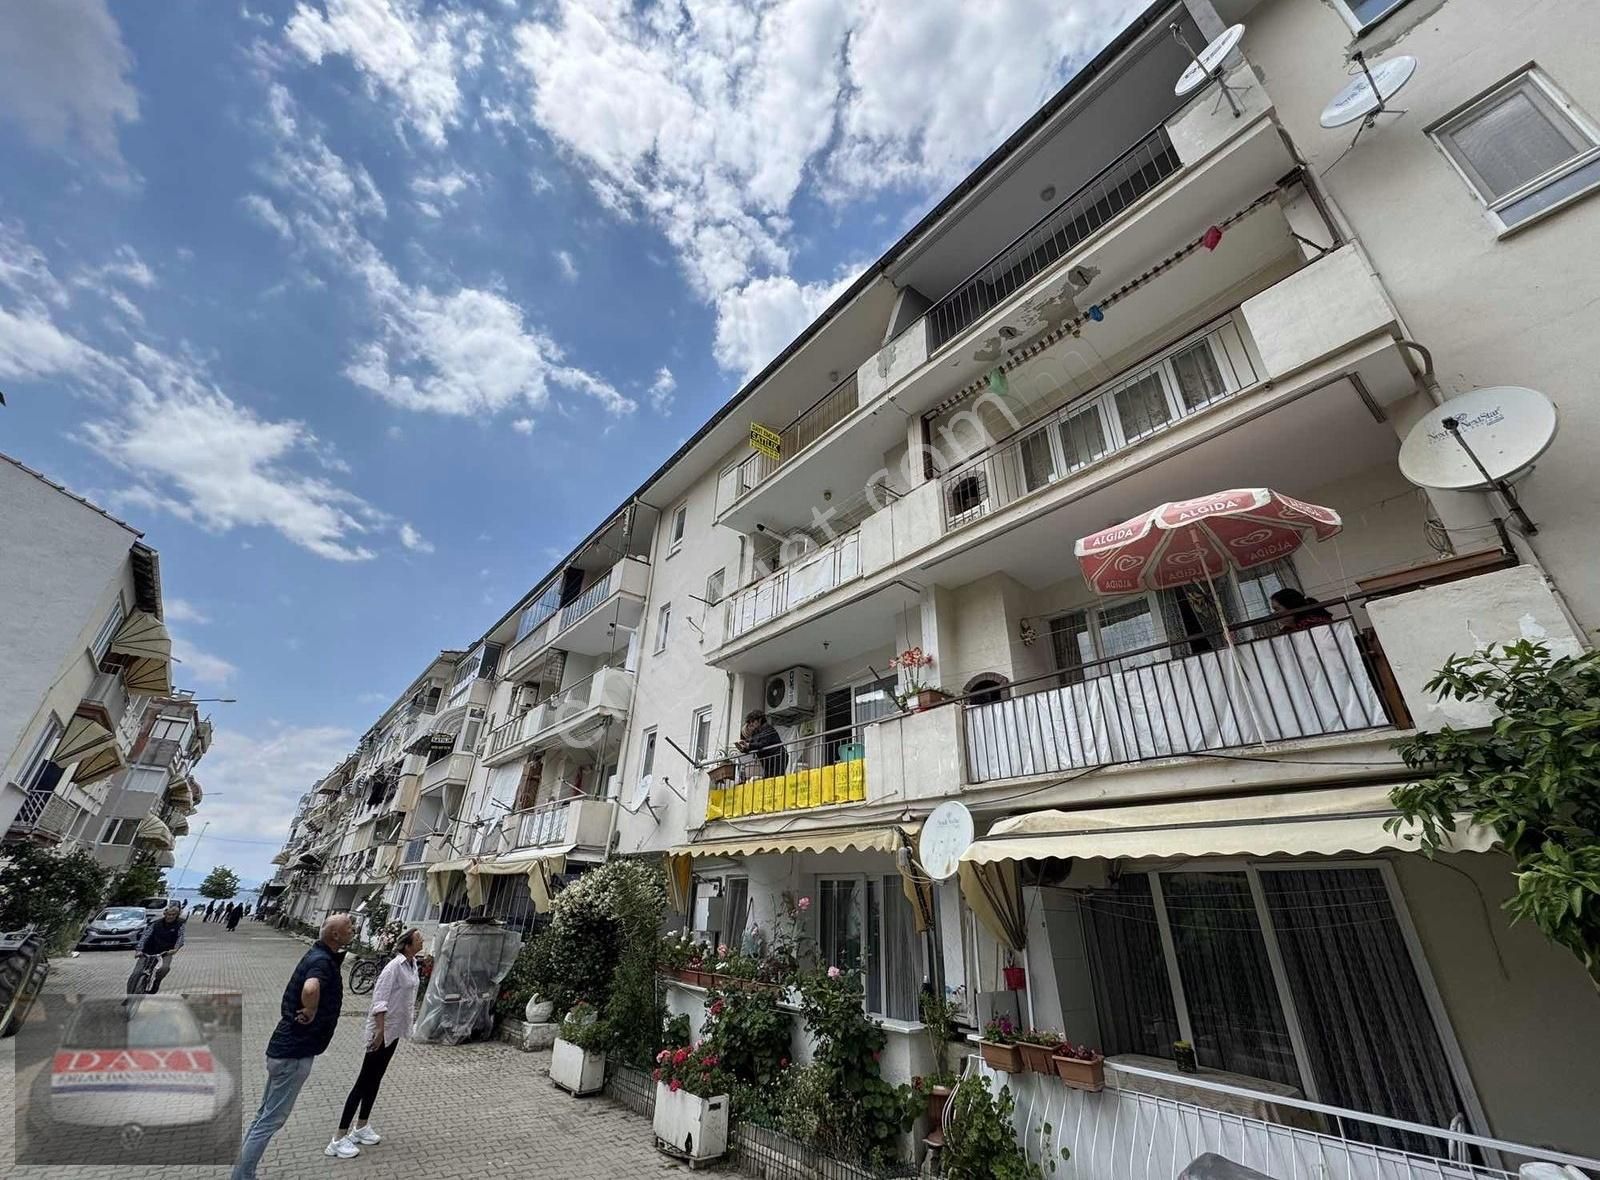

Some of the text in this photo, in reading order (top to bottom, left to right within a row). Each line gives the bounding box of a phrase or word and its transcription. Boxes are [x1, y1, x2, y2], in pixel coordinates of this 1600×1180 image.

[751, 432, 779, 452] SATILIK
[1179, 502, 1237, 520] ALGIDA
[1092, 528, 1134, 547] ALGIDA
